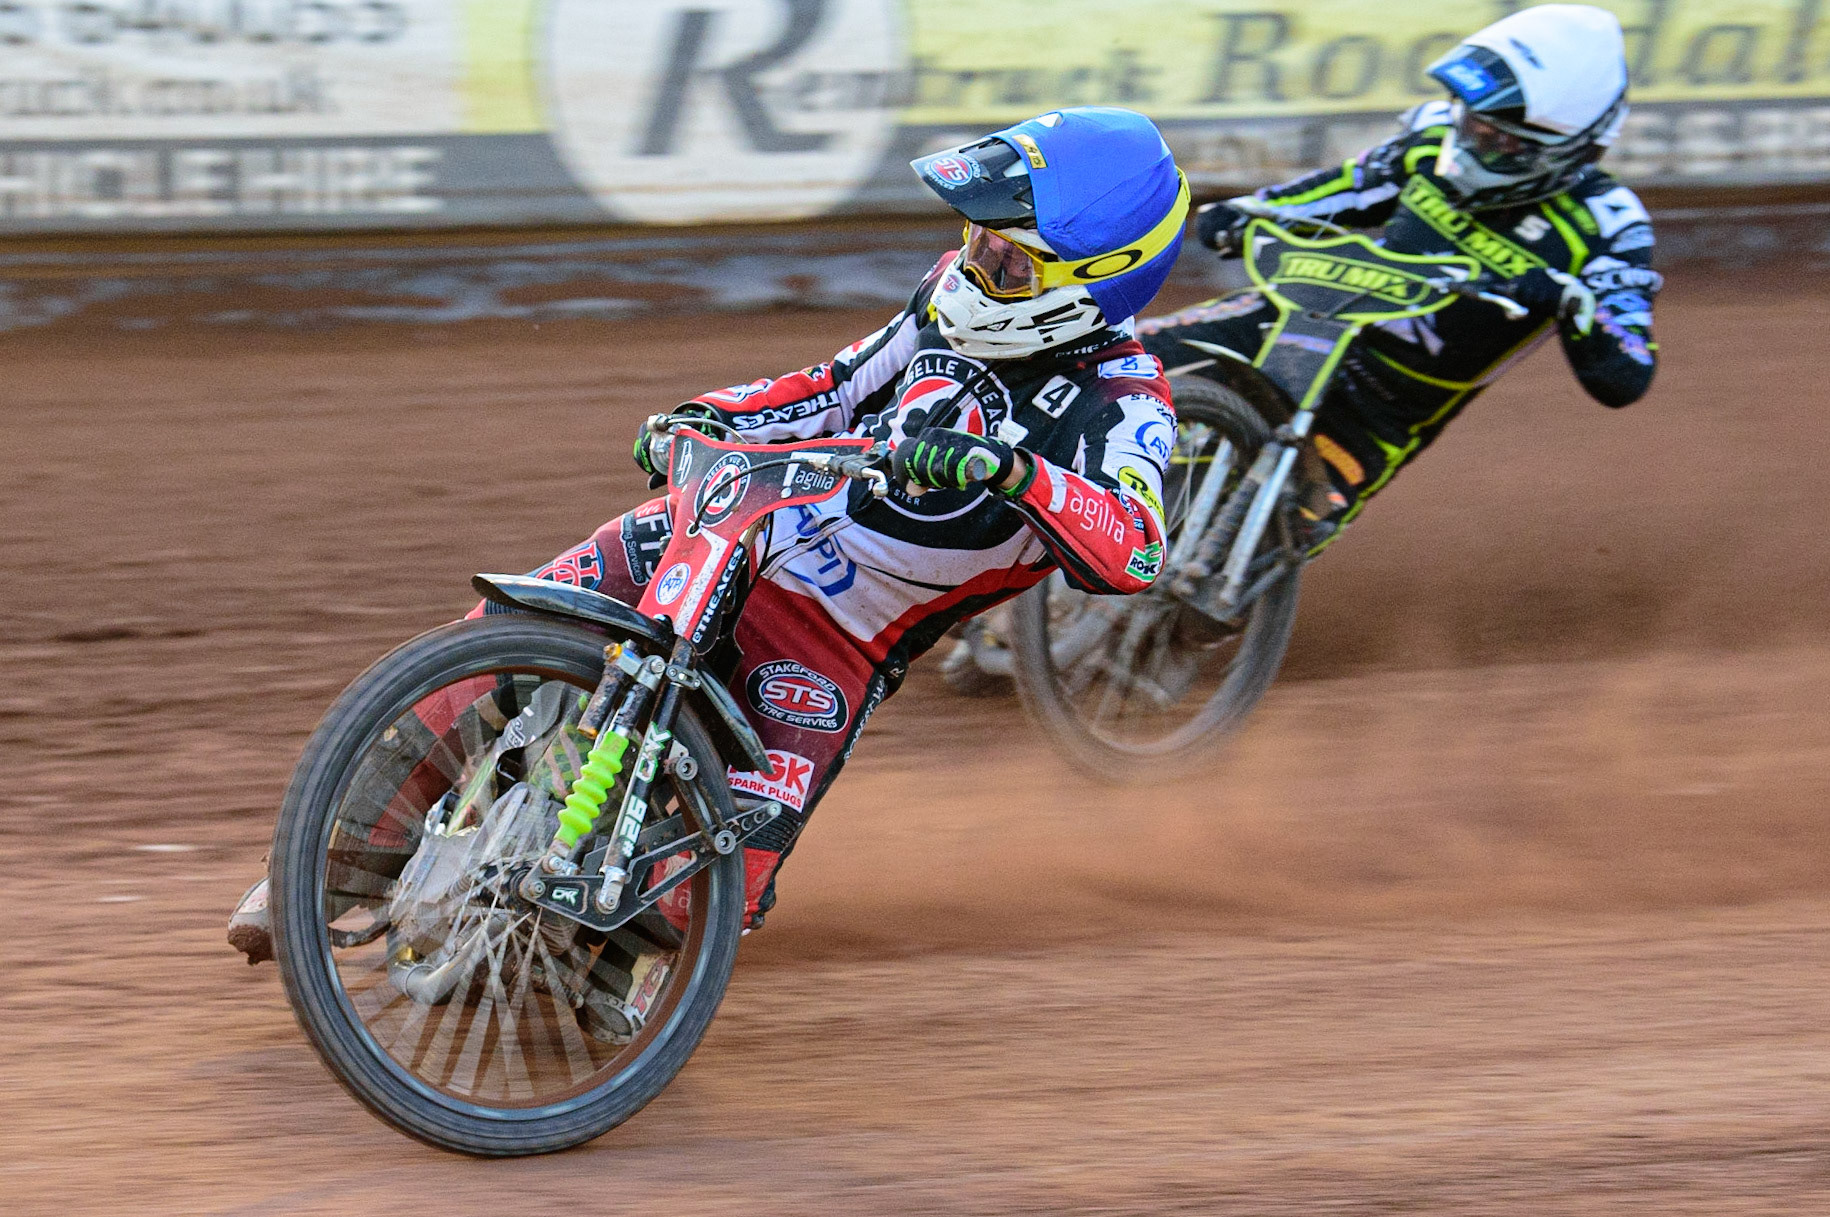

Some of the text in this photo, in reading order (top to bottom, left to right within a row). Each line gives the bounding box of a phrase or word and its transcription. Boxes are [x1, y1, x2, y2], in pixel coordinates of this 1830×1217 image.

[1410, 185, 1539, 277] TRU MIX
[1285, 257, 1407, 298] TRU MIX
[1041, 382, 1071, 418] 4
[795, 469, 835, 491] agilia
[627, 541, 643, 582] Services
[759, 663, 837, 691] STAKEFORD
[763, 680, 833, 710] STS
[757, 702, 838, 728] TYRE SERVICES
[729, 753, 810, 795] GK
[728, 777, 802, 808] SPARK PLUGS
[622, 794, 648, 858] #26
